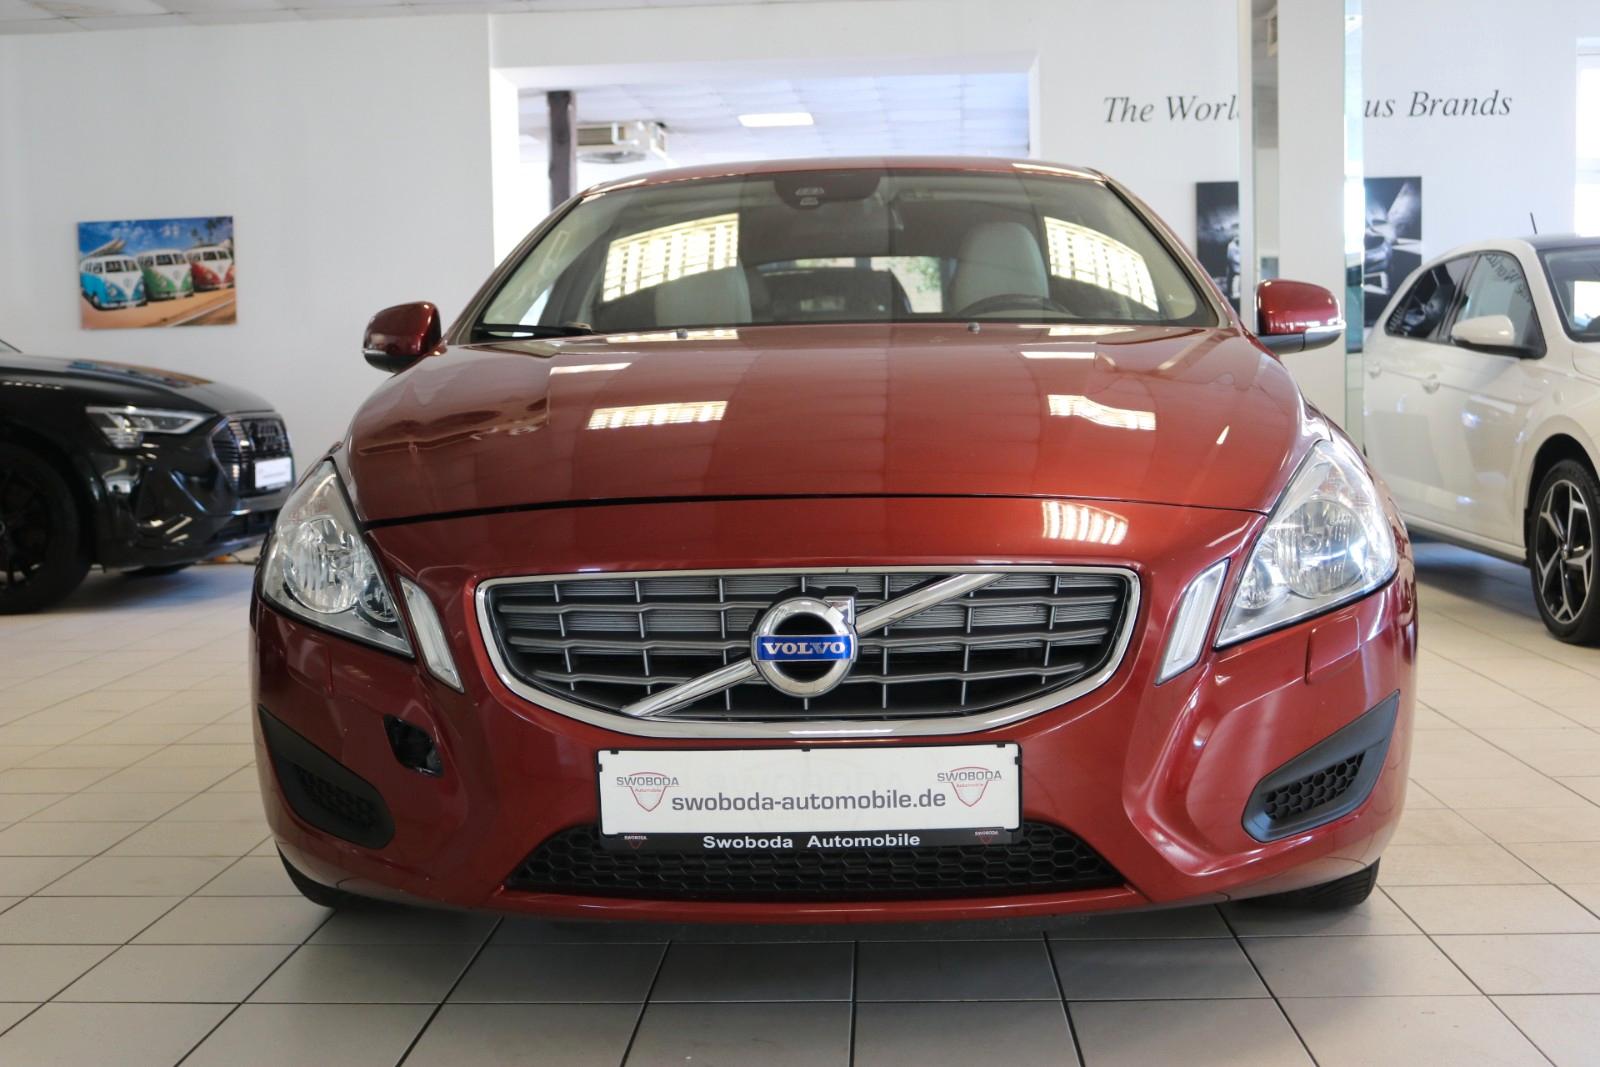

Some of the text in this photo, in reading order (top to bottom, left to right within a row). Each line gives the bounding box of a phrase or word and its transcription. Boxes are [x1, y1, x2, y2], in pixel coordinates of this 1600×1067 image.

[1103, 89, 1513, 123] The Worl us Brands
[762, 641, 846, 655] VOLVO
[616, 776, 679, 787] SWOBODA
[936, 770, 1002, 782] SWOBODA
[671, 789, 946, 811] swoboda-automobile.de
[702, 833, 921, 849] Swoboda Automobile
